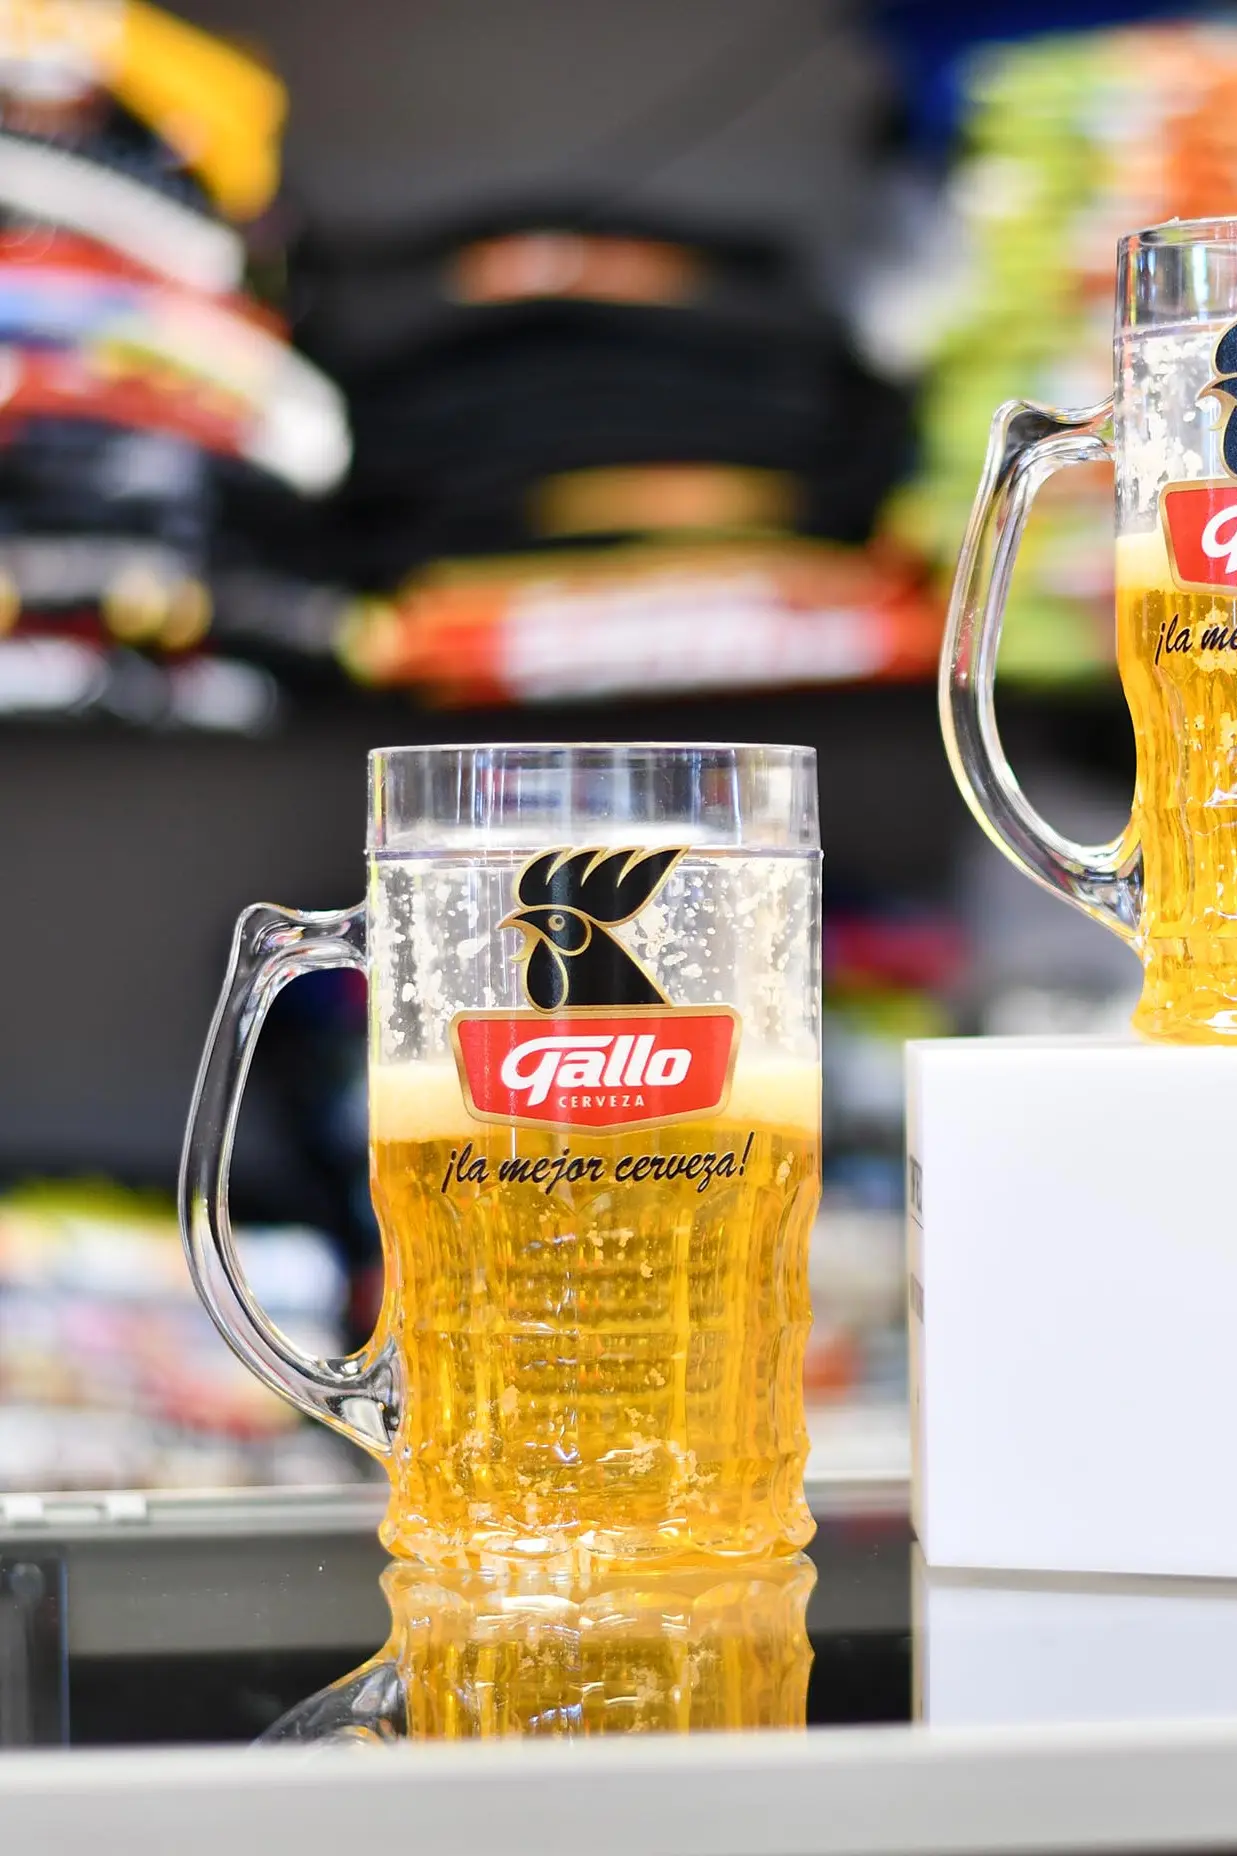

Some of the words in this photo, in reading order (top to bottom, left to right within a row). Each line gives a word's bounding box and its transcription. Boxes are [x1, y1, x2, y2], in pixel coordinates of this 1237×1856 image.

[501, 1034, 690, 1105] Gallo
[559, 1095, 643, 1108] CERVEZA
[500, 1148, 603, 1193] mejor
[615, 1131, 753, 1191] cerveza!
